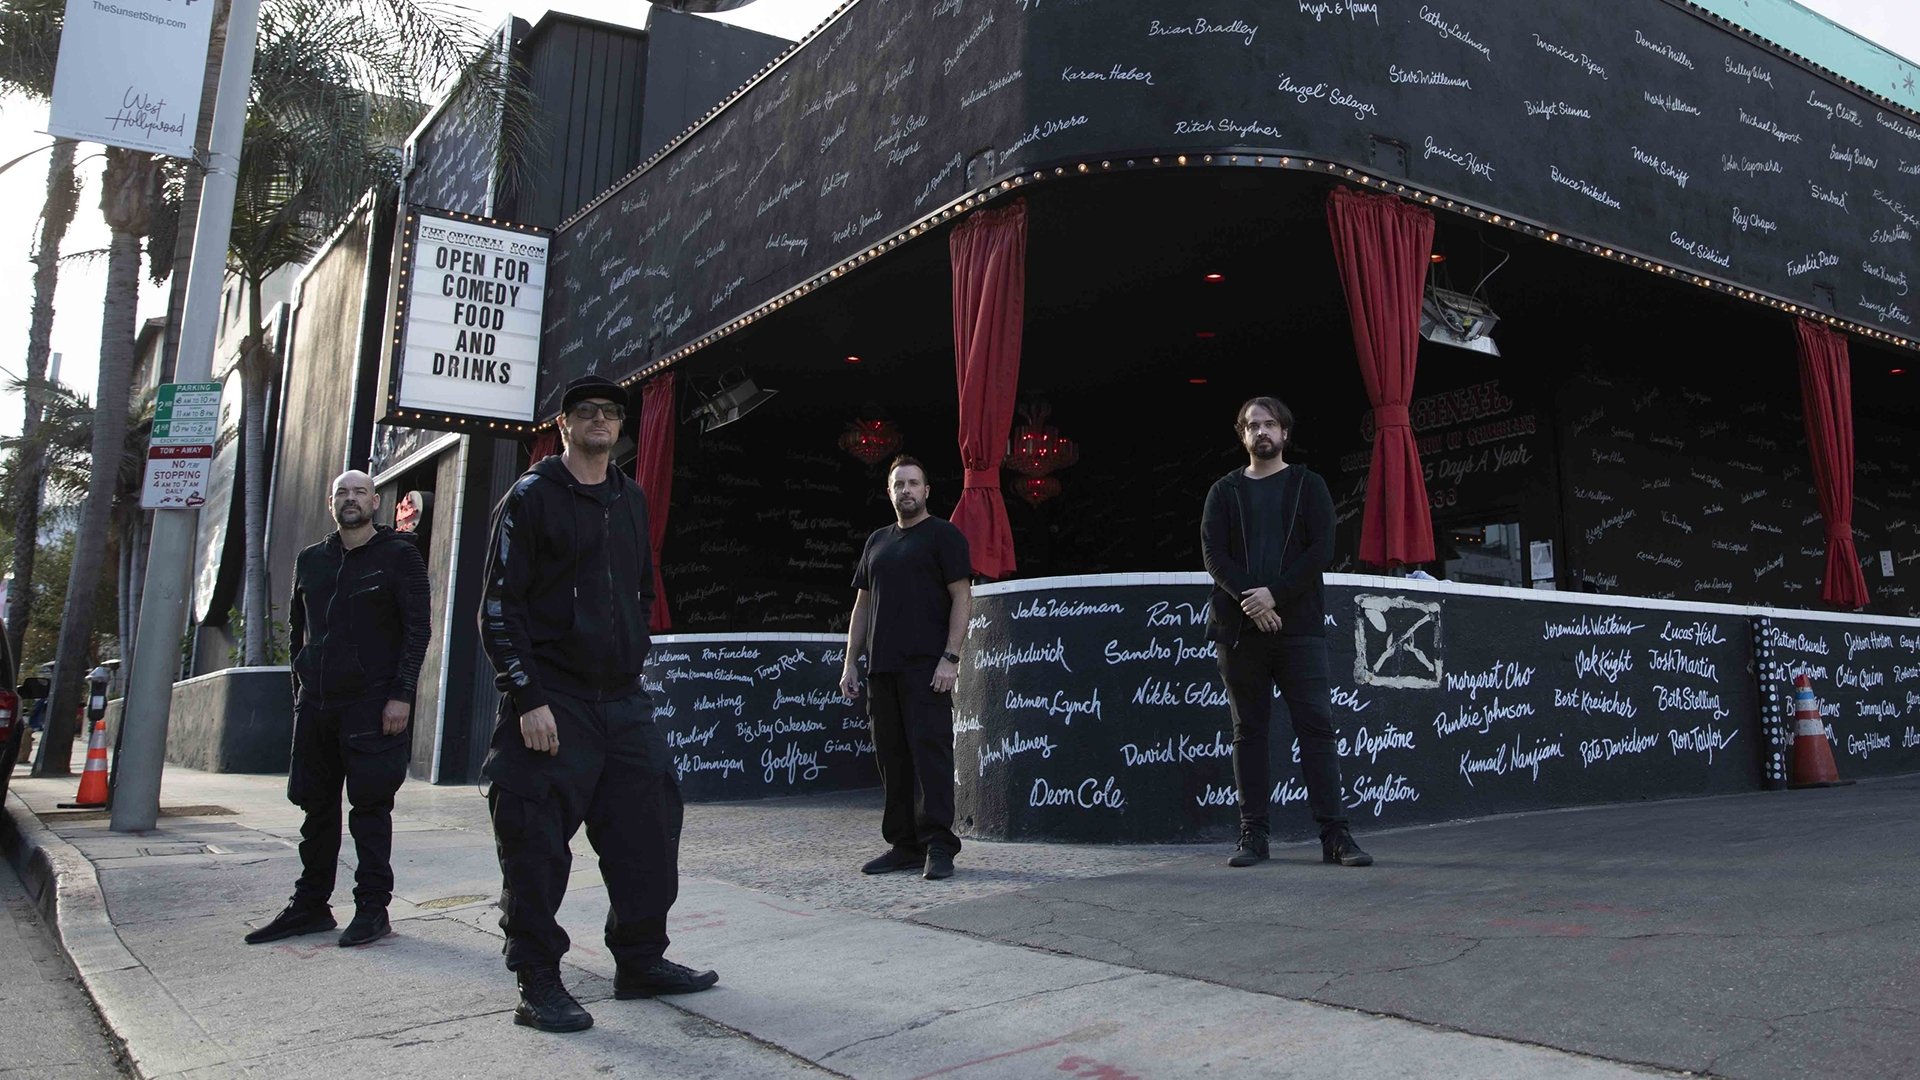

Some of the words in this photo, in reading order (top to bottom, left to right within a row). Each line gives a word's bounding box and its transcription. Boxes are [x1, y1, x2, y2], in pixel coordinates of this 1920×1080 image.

[92, 0, 187, 29] TheSunsetStrip.com
[1419, 5, 1449, 39] Cathy
[1149, 20, 1193, 36] Brian
[1194, 18, 1259, 46] Bradley
[1532, 33, 1580, 63] Monica
[1580, 53, 1609, 81] Piper
[1635, 30, 1667, 55] Dennis
[1665, 45, 1695, 71] Miller
[1061, 65, 1107, 83] Karen
[1109, 64, 1155, 86] Haber
[1389, 64, 1418, 84] Steve
[123, 85, 167, 120] West
[1329, 88, 1378, 120] Salazar
[1524, 100, 1558, 121] Bridget
[1558, 101, 1592, 120] Sienna
[1806, 90, 1834, 120] Lenny
[105, 109, 186, 139] Hollywood
[1173, 120, 1216, 135] Ritch
[1217, 118, 1283, 139] Shydner
[1738, 107, 1772, 133] Michael
[1423, 135, 1467, 167] Janice
[1464, 152, 1496, 182] Hart
[1631, 146, 1660, 175] Mark
[1659, 160, 1690, 189] Schiff
[1550, 164, 1580, 190] Bruce
[1579, 180, 1621, 210] Mikelson
[1732, 206, 1749, 231] Ray
[1749, 213, 1778, 235] Chapa
[421, 225, 446, 241] THE
[446, 231, 505, 252] ORIGINAL
[510, 242, 546, 260] ROOM
[1669, 231, 1696, 255] Carol
[1696, 244, 1731, 269] Siskind
[435, 246, 486, 277] OPEN
[494, 257, 530, 283] FOR
[442, 273, 520, 307] COMEDY
[453, 302, 505, 331] FOOD
[455, 329, 496, 356] AND
[432, 352, 512, 384] DRINKS
[176, 384, 212, 392] PARKING
[200, 396, 208, 404] 10
[157, 400, 165, 412] 2
[153, 424, 160, 434] 4
[172, 425, 180, 433] 10
[172, 460, 185, 469] NO
[181, 446, 202, 454] AWAY
[1438, 455, 1474, 486] Days
[1493, 443, 1535, 473] Year
[153, 471, 201, 480] STOPPING
[1011, 598, 1048, 620] Jake
[1048, 598, 1125, 617] Weisman
[1147, 601, 1183, 628] Ron
[1543, 614, 1592, 641] Jeremiah
[1590, 613, 1646, 636] Watkins
[1660, 620, 1694, 642] Lucas
[1769, 627, 1799, 651] Patton
[1798, 633, 1830, 656] Oswalt
[702, 647, 718, 661] Ron
[717, 645, 761, 661] Funches
[753, 662, 782, 681] Tony
[777, 648, 812, 672] Rock
[820, 649, 844, 666] Rick
[974, 646, 1004, 670] Chris
[1001, 636, 1072, 675] Hardwick
[1104, 637, 1171, 665] Sandro
[1597, 648, 1634, 684] Knight
[1648, 649, 1676, 671] Josh
[1674, 649, 1719, 683] Martin
[1131, 676, 1181, 706] Nikki
[1446, 659, 1503, 700] Margaret
[1504, 661, 1537, 688] Cho
[1835, 663, 1858, 688] Colin
[1859, 664, 1885, 692] Quinn
[715, 692, 746, 716] Hong
[1005, 690, 1050, 710] Carmen
[1050, 687, 1102, 726] Lynch
[1554, 687, 1580, 708] Bert
[1580, 690, 1638, 719] Kreischer
[1652, 685, 1684, 711] Beth
[1682, 686, 1730, 720] Stelling
[736, 720, 756, 743] Big
[753, 719, 774, 743] Jay
[774, 715, 827, 736] Oakerson
[841, 716, 870, 730] Eric
[1432, 709, 1482, 740] Punkie
[1478, 698, 1536, 735] Johnson
[824, 738, 853, 754] Gina
[977, 742, 1004, 777] John
[1002, 730, 1058, 760] Mulaney
[1120, 741, 1176, 767] David
[1354, 722, 1416, 765] Pepitone
[1579, 739, 1604, 769] Pete
[1602, 727, 1660, 761] Davidson
[1667, 728, 1694, 756] Ron
[1689, 723, 1740, 766] Taylor
[692, 749, 745, 779] Dunnigan
[760, 740, 829, 785] Godfrey
[1458, 743, 1508, 788] Kumail
[1029, 777, 1076, 809] Deon
[1076, 775, 1126, 809] Cole
[1347, 773, 1420, 817] Singleton
